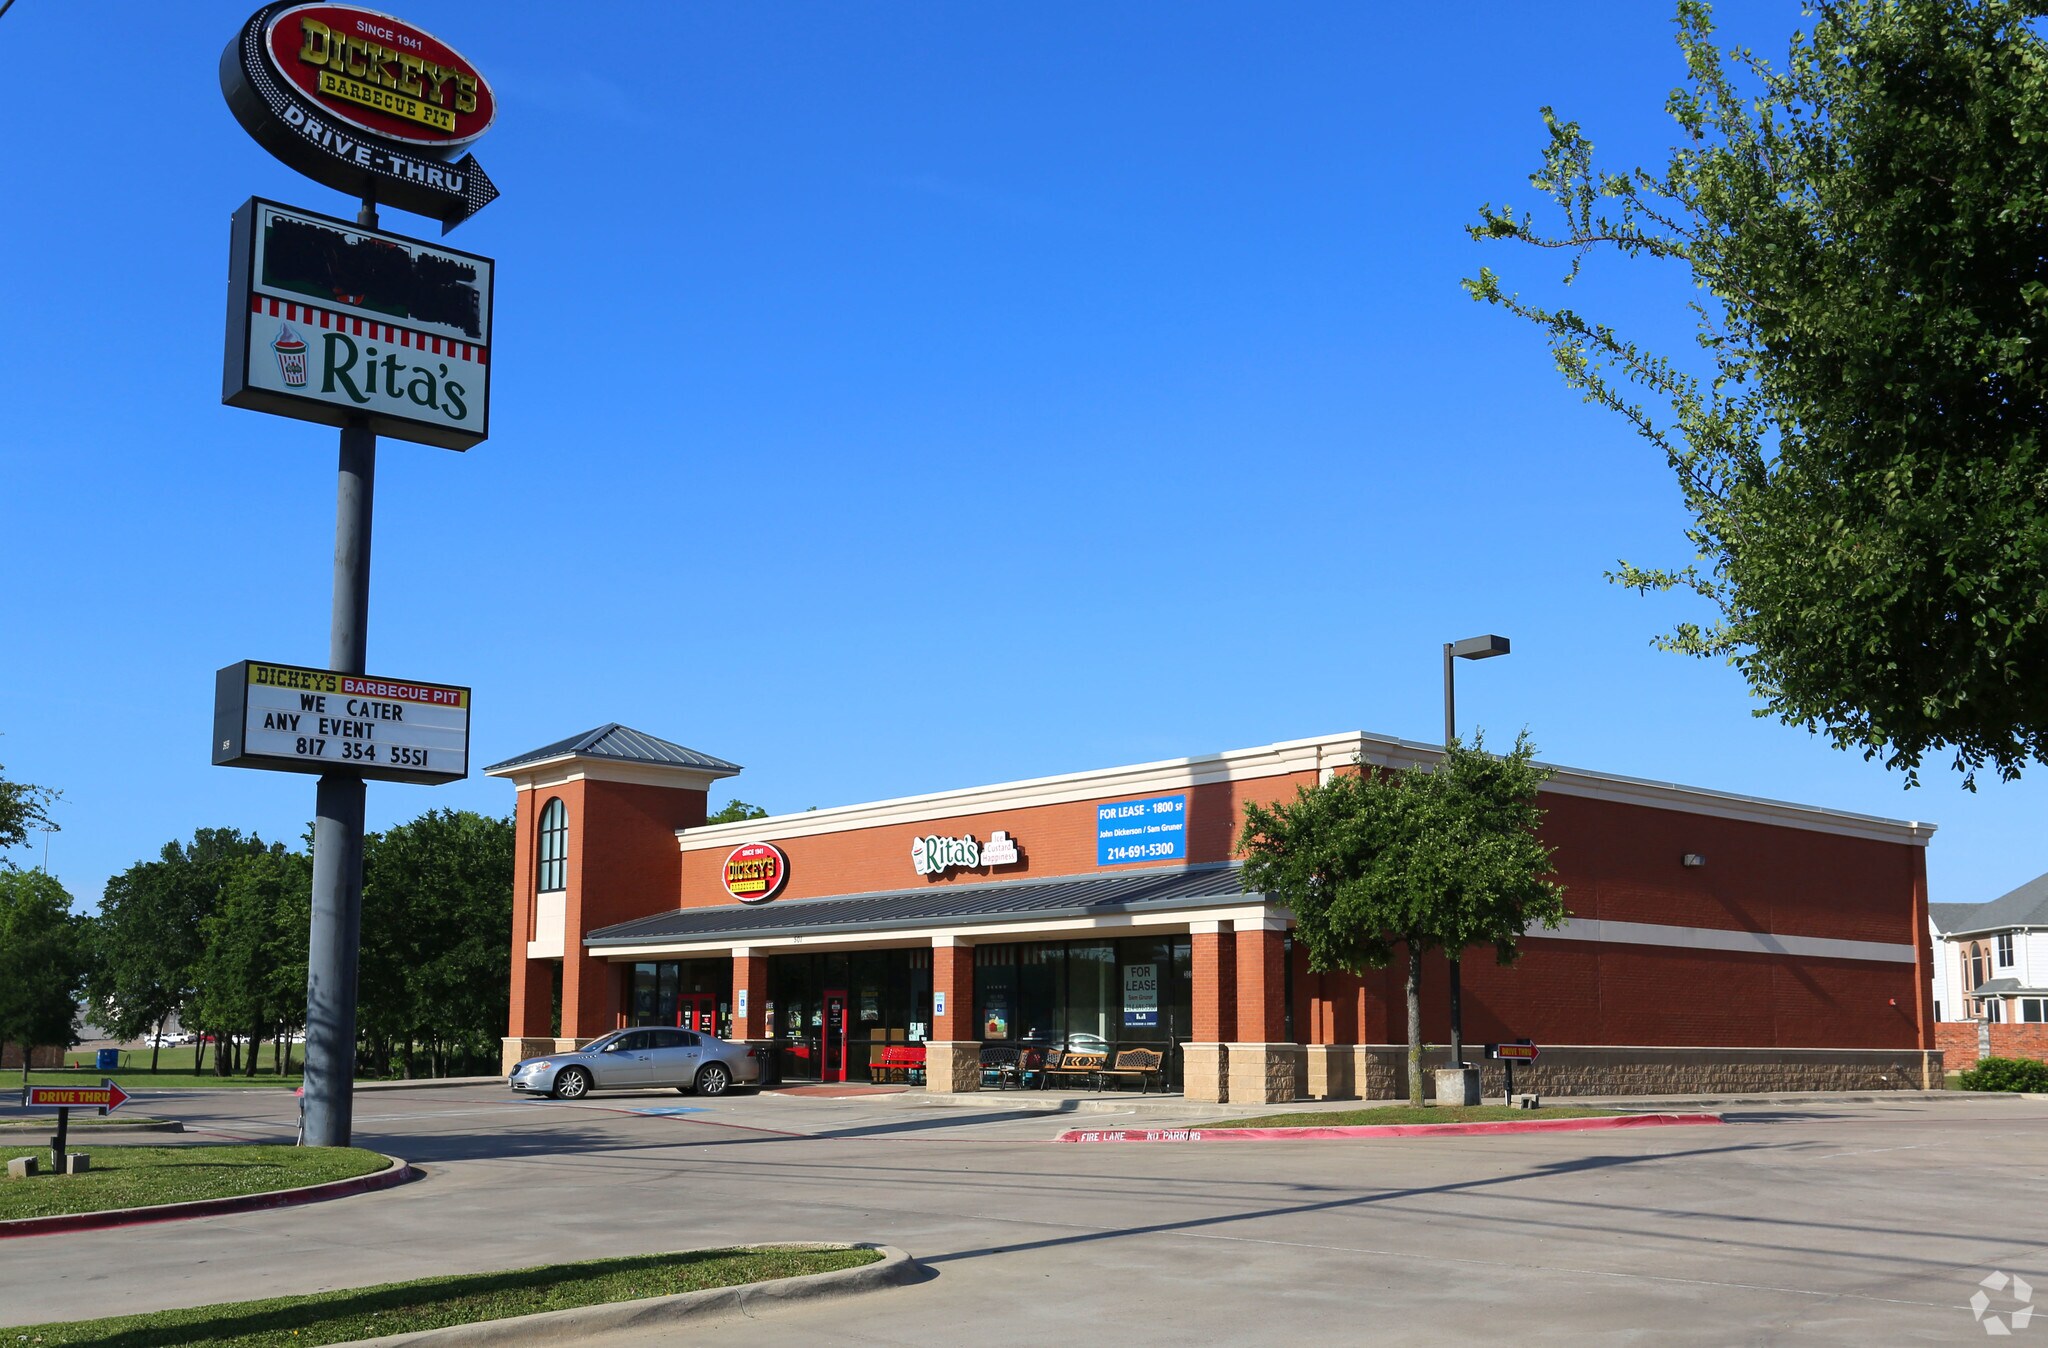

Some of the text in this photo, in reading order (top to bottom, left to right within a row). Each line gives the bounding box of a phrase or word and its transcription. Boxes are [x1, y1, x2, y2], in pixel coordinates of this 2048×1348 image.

[357, 20, 423, 51] SINCE 1941
[300, 17, 478, 113] DICKEY'S
[325, 75, 450, 127] BARBECUE PIT
[283, 104, 464, 192] DRIVE-THRU
[320, 332, 468, 421] Rita's
[256, 666, 458, 704] DICKEY'S BARBECUE PIT
[300, 693, 403, 722] WE CATER
[264, 713, 375, 740] ANY EVENT
[296, 737, 326, 756] 817
[342, 741, 376, 761] 354
[1099, 808, 1117, 820] FOR
[1118, 804, 1145, 818] LEASE
[1152, 801, 1173, 814] 1800
[1099, 829, 1113, 839] John
[1114, 827, 1142, 837] Dickerson
[1147, 825, 1160, 833] Sam
[1161, 823, 1183, 832] Gruner
[926, 837, 1012, 871] Rita's Custard
[982, 852, 1015, 863] Happiness
[1107, 842, 1174, 860] 214-691-5300
[728, 856, 775, 880] DICKEY'S
[1131, 966, 1151, 978] FOR
[1125, 980, 1156, 991] LEASE
[39, 1091, 111, 1103] DRIVE THRU
[1081, 1130, 1201, 1141] FIRE LANE NO PARKING
